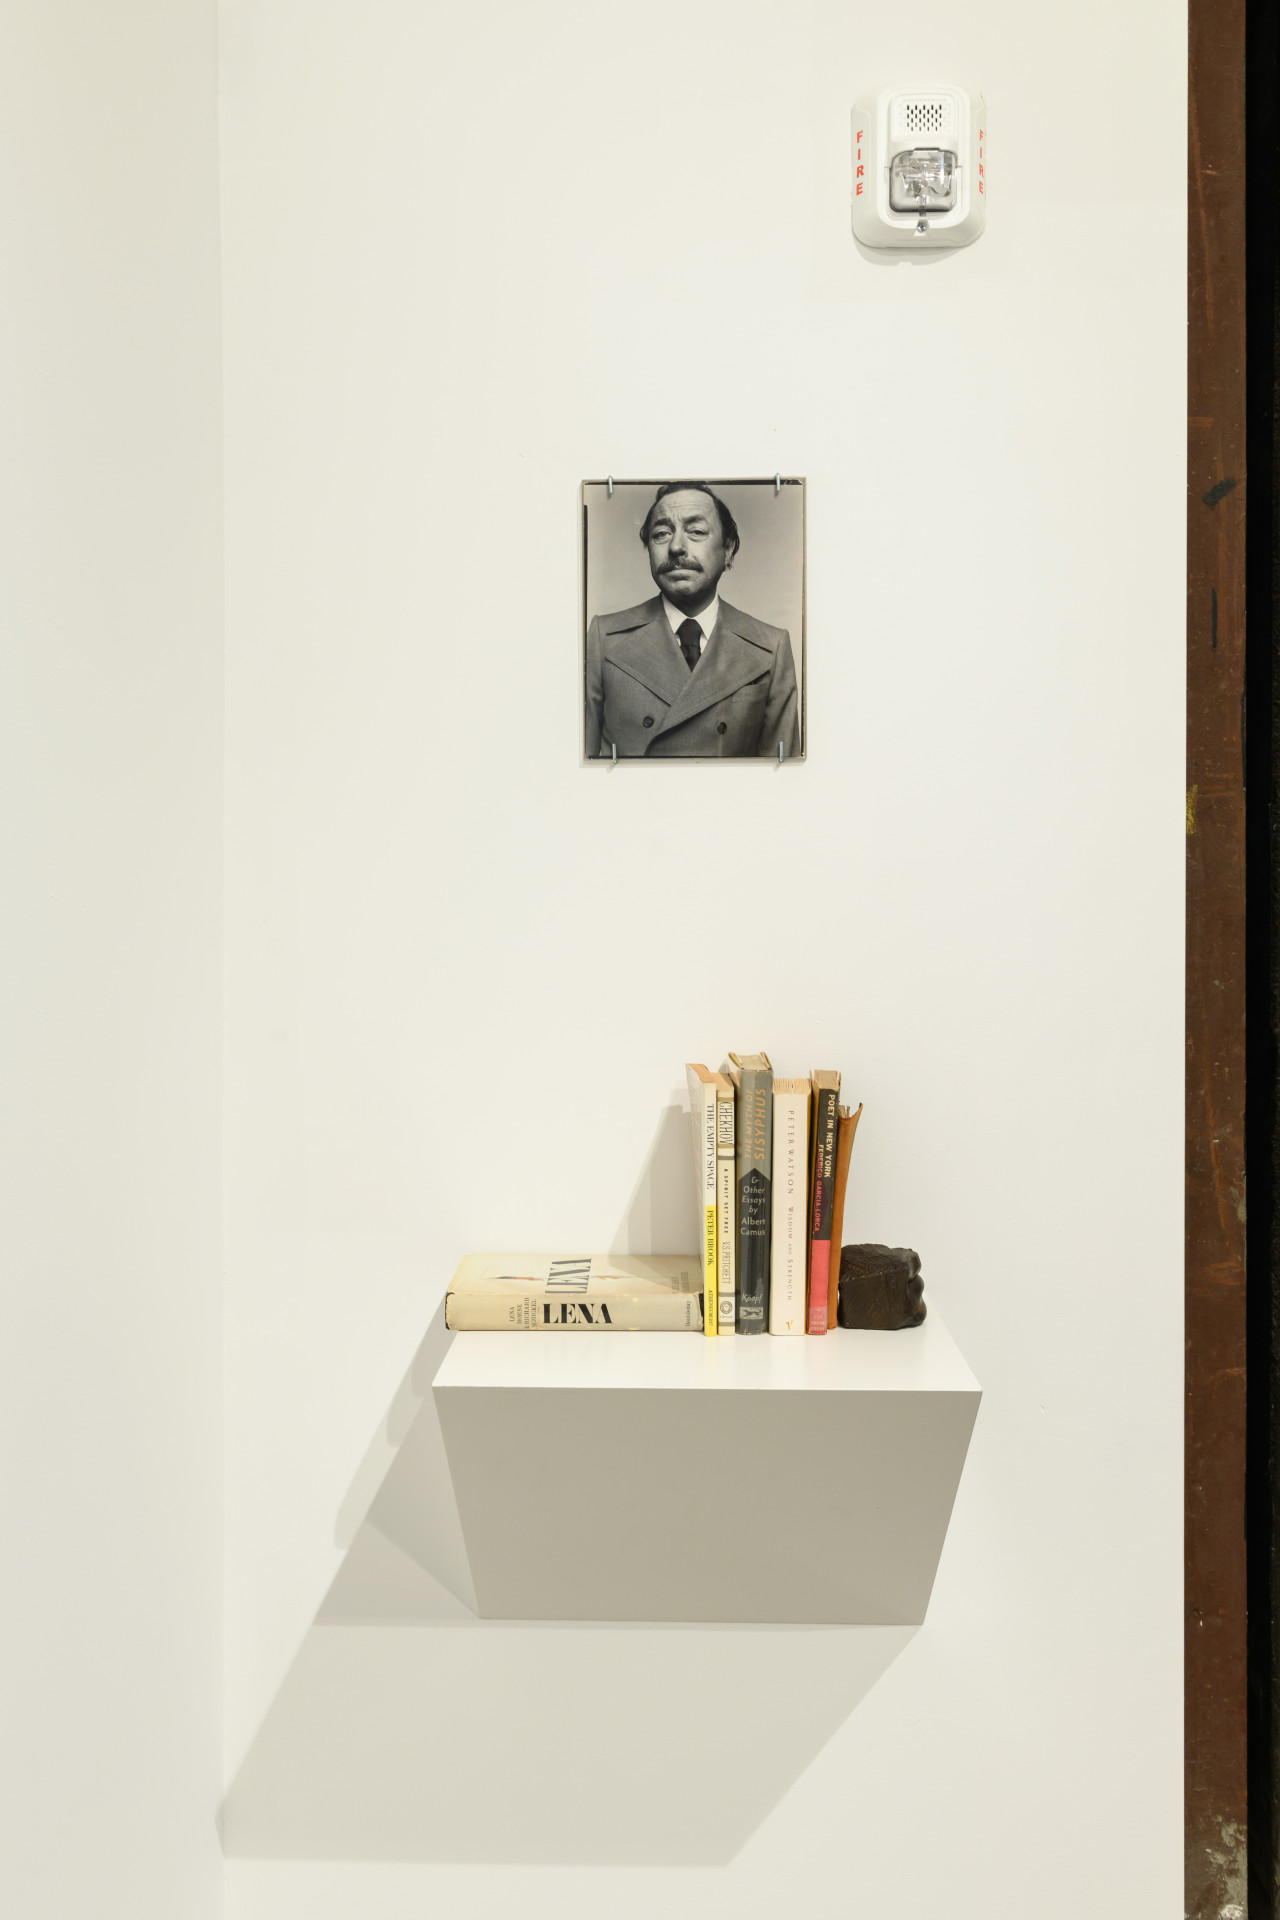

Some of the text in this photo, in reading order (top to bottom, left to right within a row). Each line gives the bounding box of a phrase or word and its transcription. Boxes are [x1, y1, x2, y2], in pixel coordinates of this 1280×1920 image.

[856, 130, 865, 196] FIRE
[719, 1101, 733, 1145] CHEKHOV
[744, 1088, 754, 1160] THE MYTH OF
[754, 1088, 766, 1161] SISYPHUS
[824, 1094, 836, 1178] POET IN NEW YORK
[706, 1104, 715, 1190] THE EMPTY SPACE
[787, 1110, 795, 1195] PETER WATSON
[817, 1144, 825, 1178] FEDERICO
[743, 1185, 765, 1194] Other
[751, 1176, 760, 1184] &
[741, 1195, 766, 1205] Essays
[749, 1204, 759, 1215] by
[740, 1227, 766, 1237] Camus
[741, 1216, 766, 1226] Albert
[707, 1238, 715, 1266] BROOK
[545, 1258, 592, 1294] LENA
[542, 1303, 613, 1324] LENA
[741, 1293, 764, 1305] Knopf
